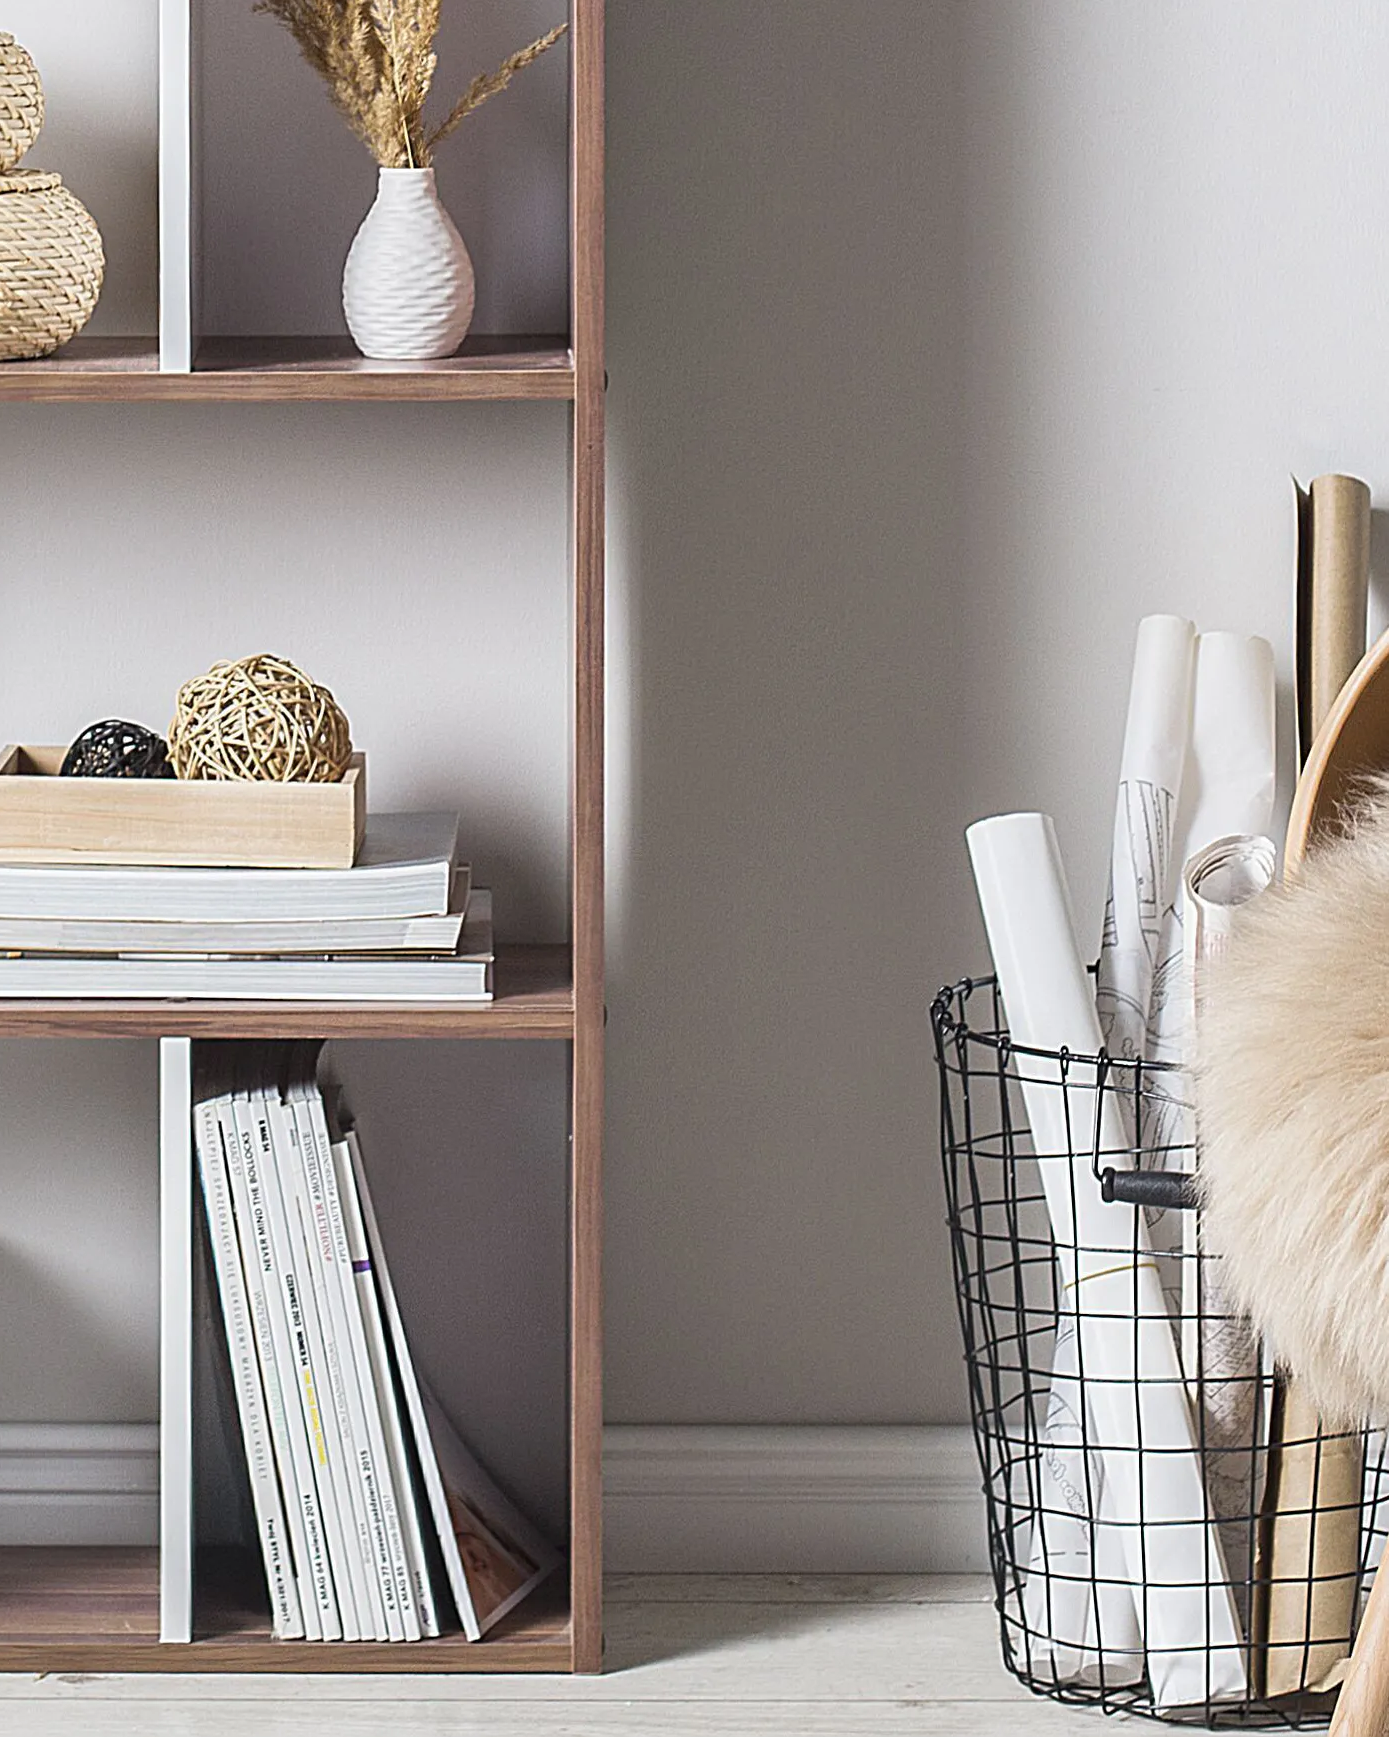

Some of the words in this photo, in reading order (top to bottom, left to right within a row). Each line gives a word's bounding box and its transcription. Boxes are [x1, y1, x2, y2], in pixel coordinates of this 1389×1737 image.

[202, 1111, 220, 1171] NAJLEPIEJ
[227, 1139, 239, 1165] MAG
[240, 1130, 258, 1184] BOLLOCKS
[301, 1131, 321, 1201] #MOVIEISSUE
[249, 1186, 261, 1205] THE
[253, 1207, 266, 1236] MIND
[314, 1201, 333, 1262] #NOFILTER
[328, 1198, 347, 1264] #PUREBEAUTY
[258, 1237, 272, 1272] NEVER
[229, 1284, 248, 1351] LUKSUSOWY
[291, 1309, 301, 1327] 2013
[240, 1356, 256, 1408] MAGAZYN
[249, 1413, 260, 1434] DLA
[253, 1440, 268, 1480] KOBIET
[302, 1493, 314, 1517] 2014
[314, 1561, 324, 1574] 64
[380, 1564, 389, 1576] 77
[318, 1575, 328, 1600] MAG
[384, 1578, 393, 1601] MAG
[399, 1578, 408, 1601] MAG
[402, 1603, 410, 1611] K
